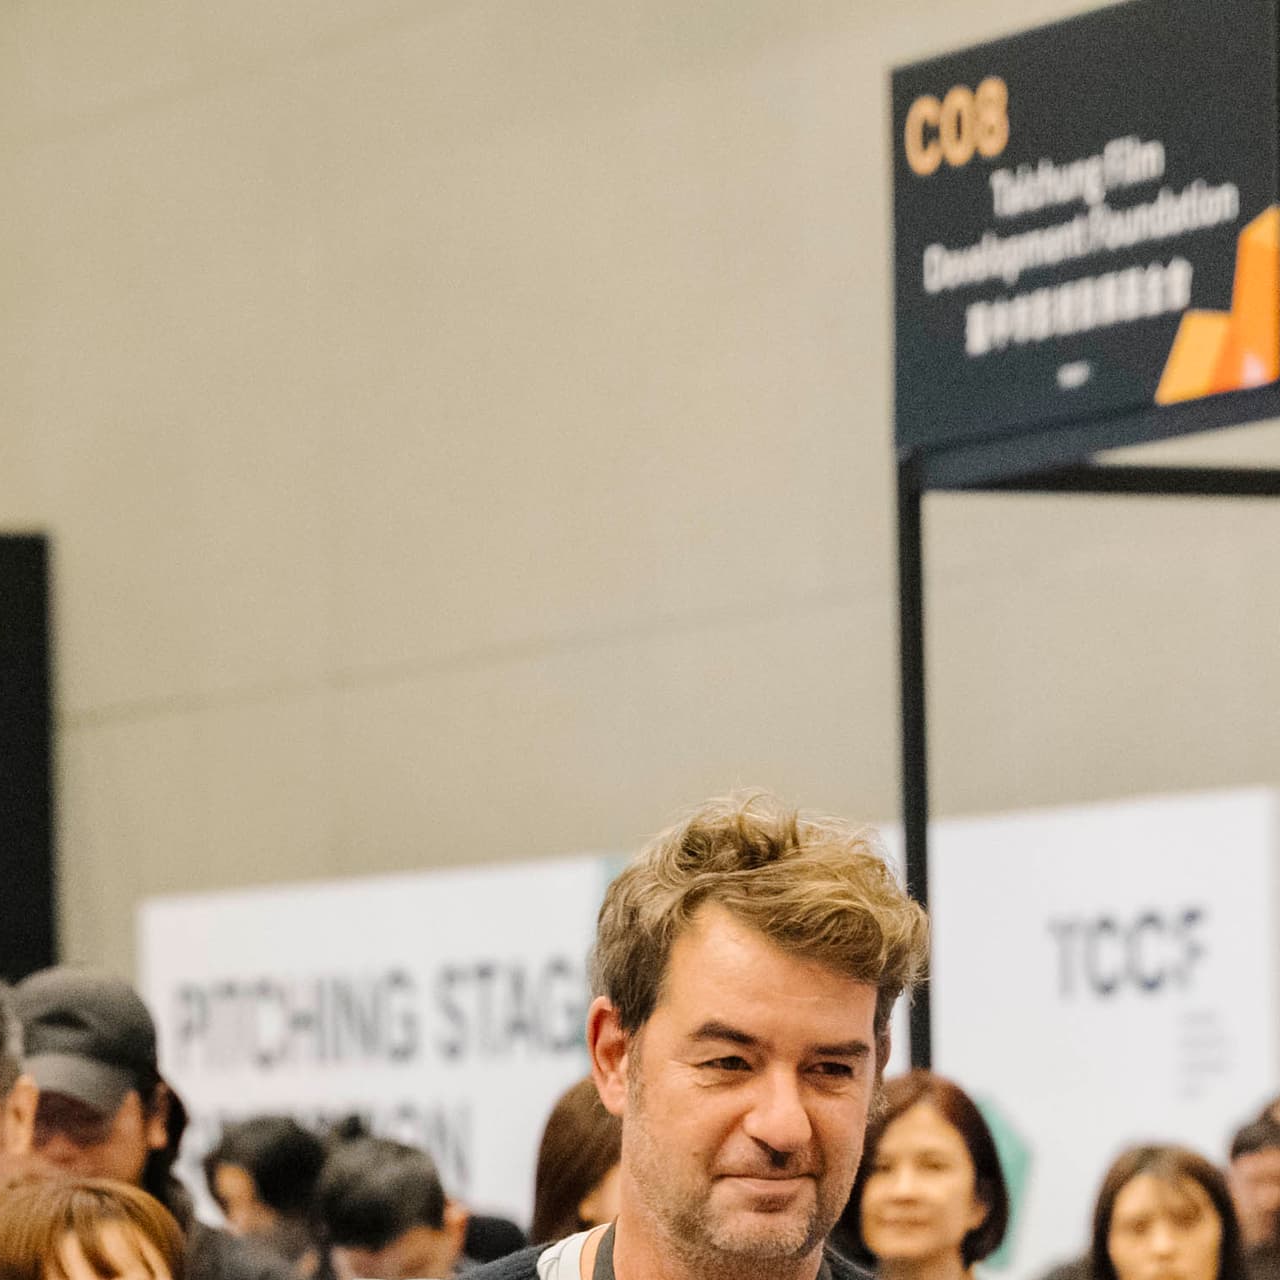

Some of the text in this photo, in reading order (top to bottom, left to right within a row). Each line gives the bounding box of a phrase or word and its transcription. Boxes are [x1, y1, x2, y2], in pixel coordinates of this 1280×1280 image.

[1048, 906, 1207, 999] TCCF
[174, 953, 589, 1068] PITCHING STAG
